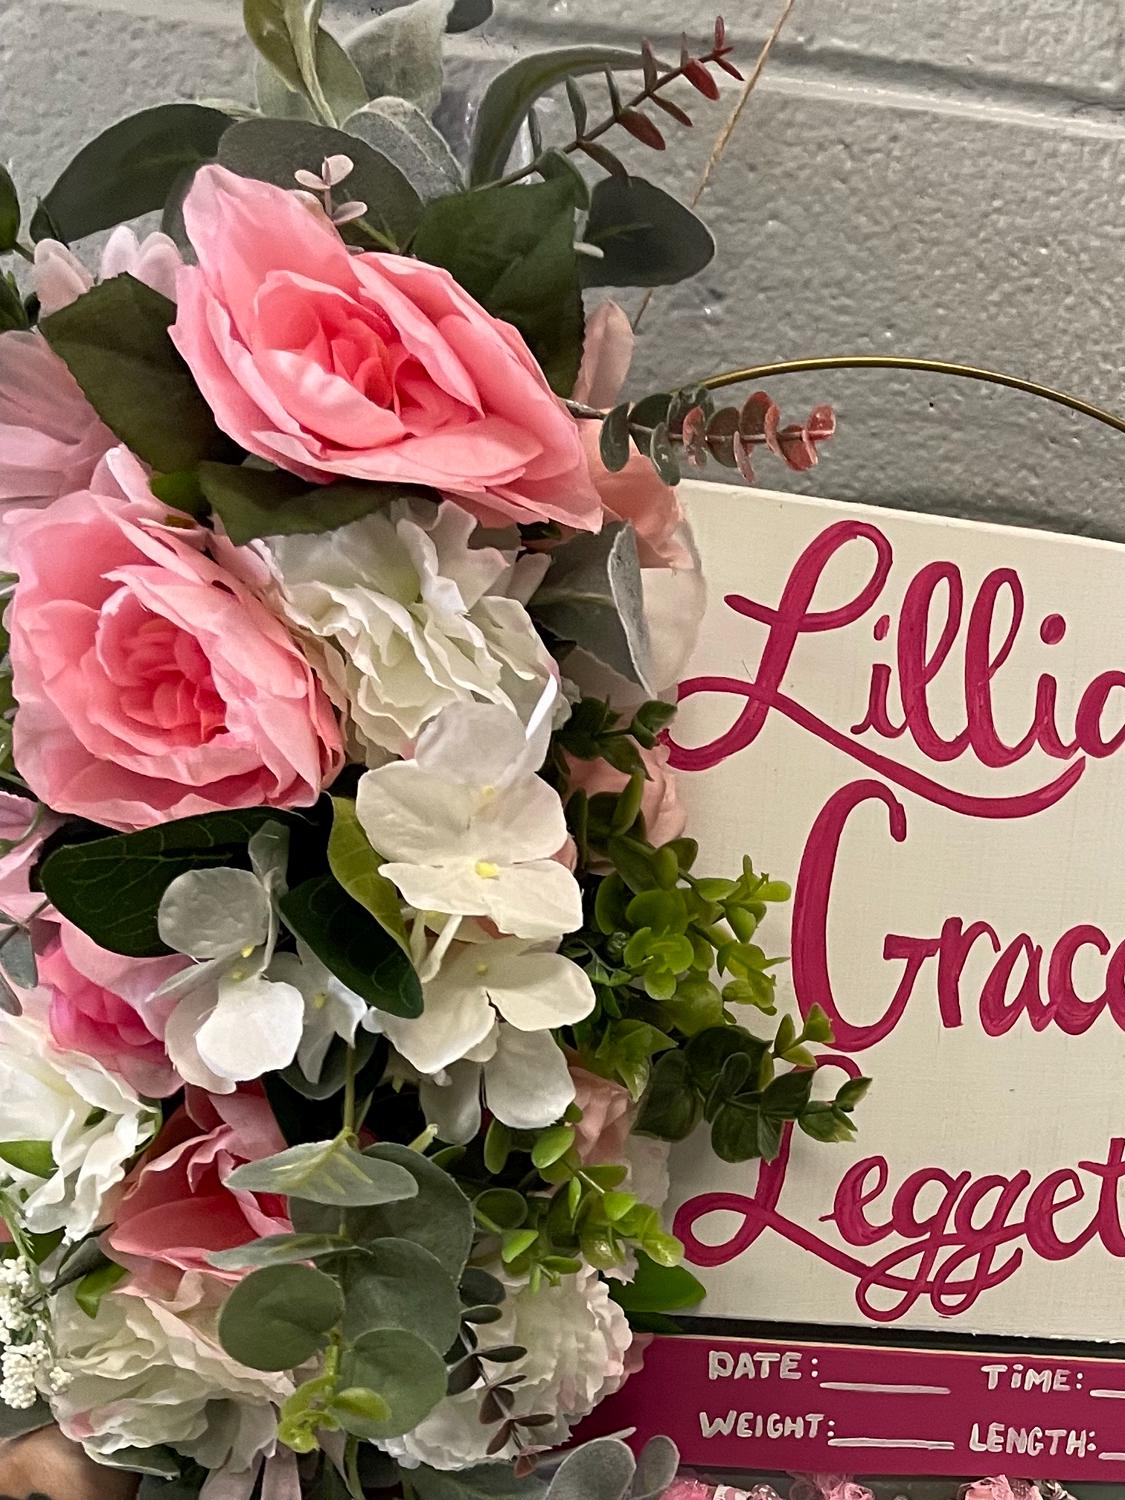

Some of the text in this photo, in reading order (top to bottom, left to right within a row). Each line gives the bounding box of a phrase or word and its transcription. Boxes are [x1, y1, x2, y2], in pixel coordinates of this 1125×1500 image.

[707, 1350, 819, 1381] DATE:
[699, 1409, 1097, 1458] WEIGHT: LENGTH:
